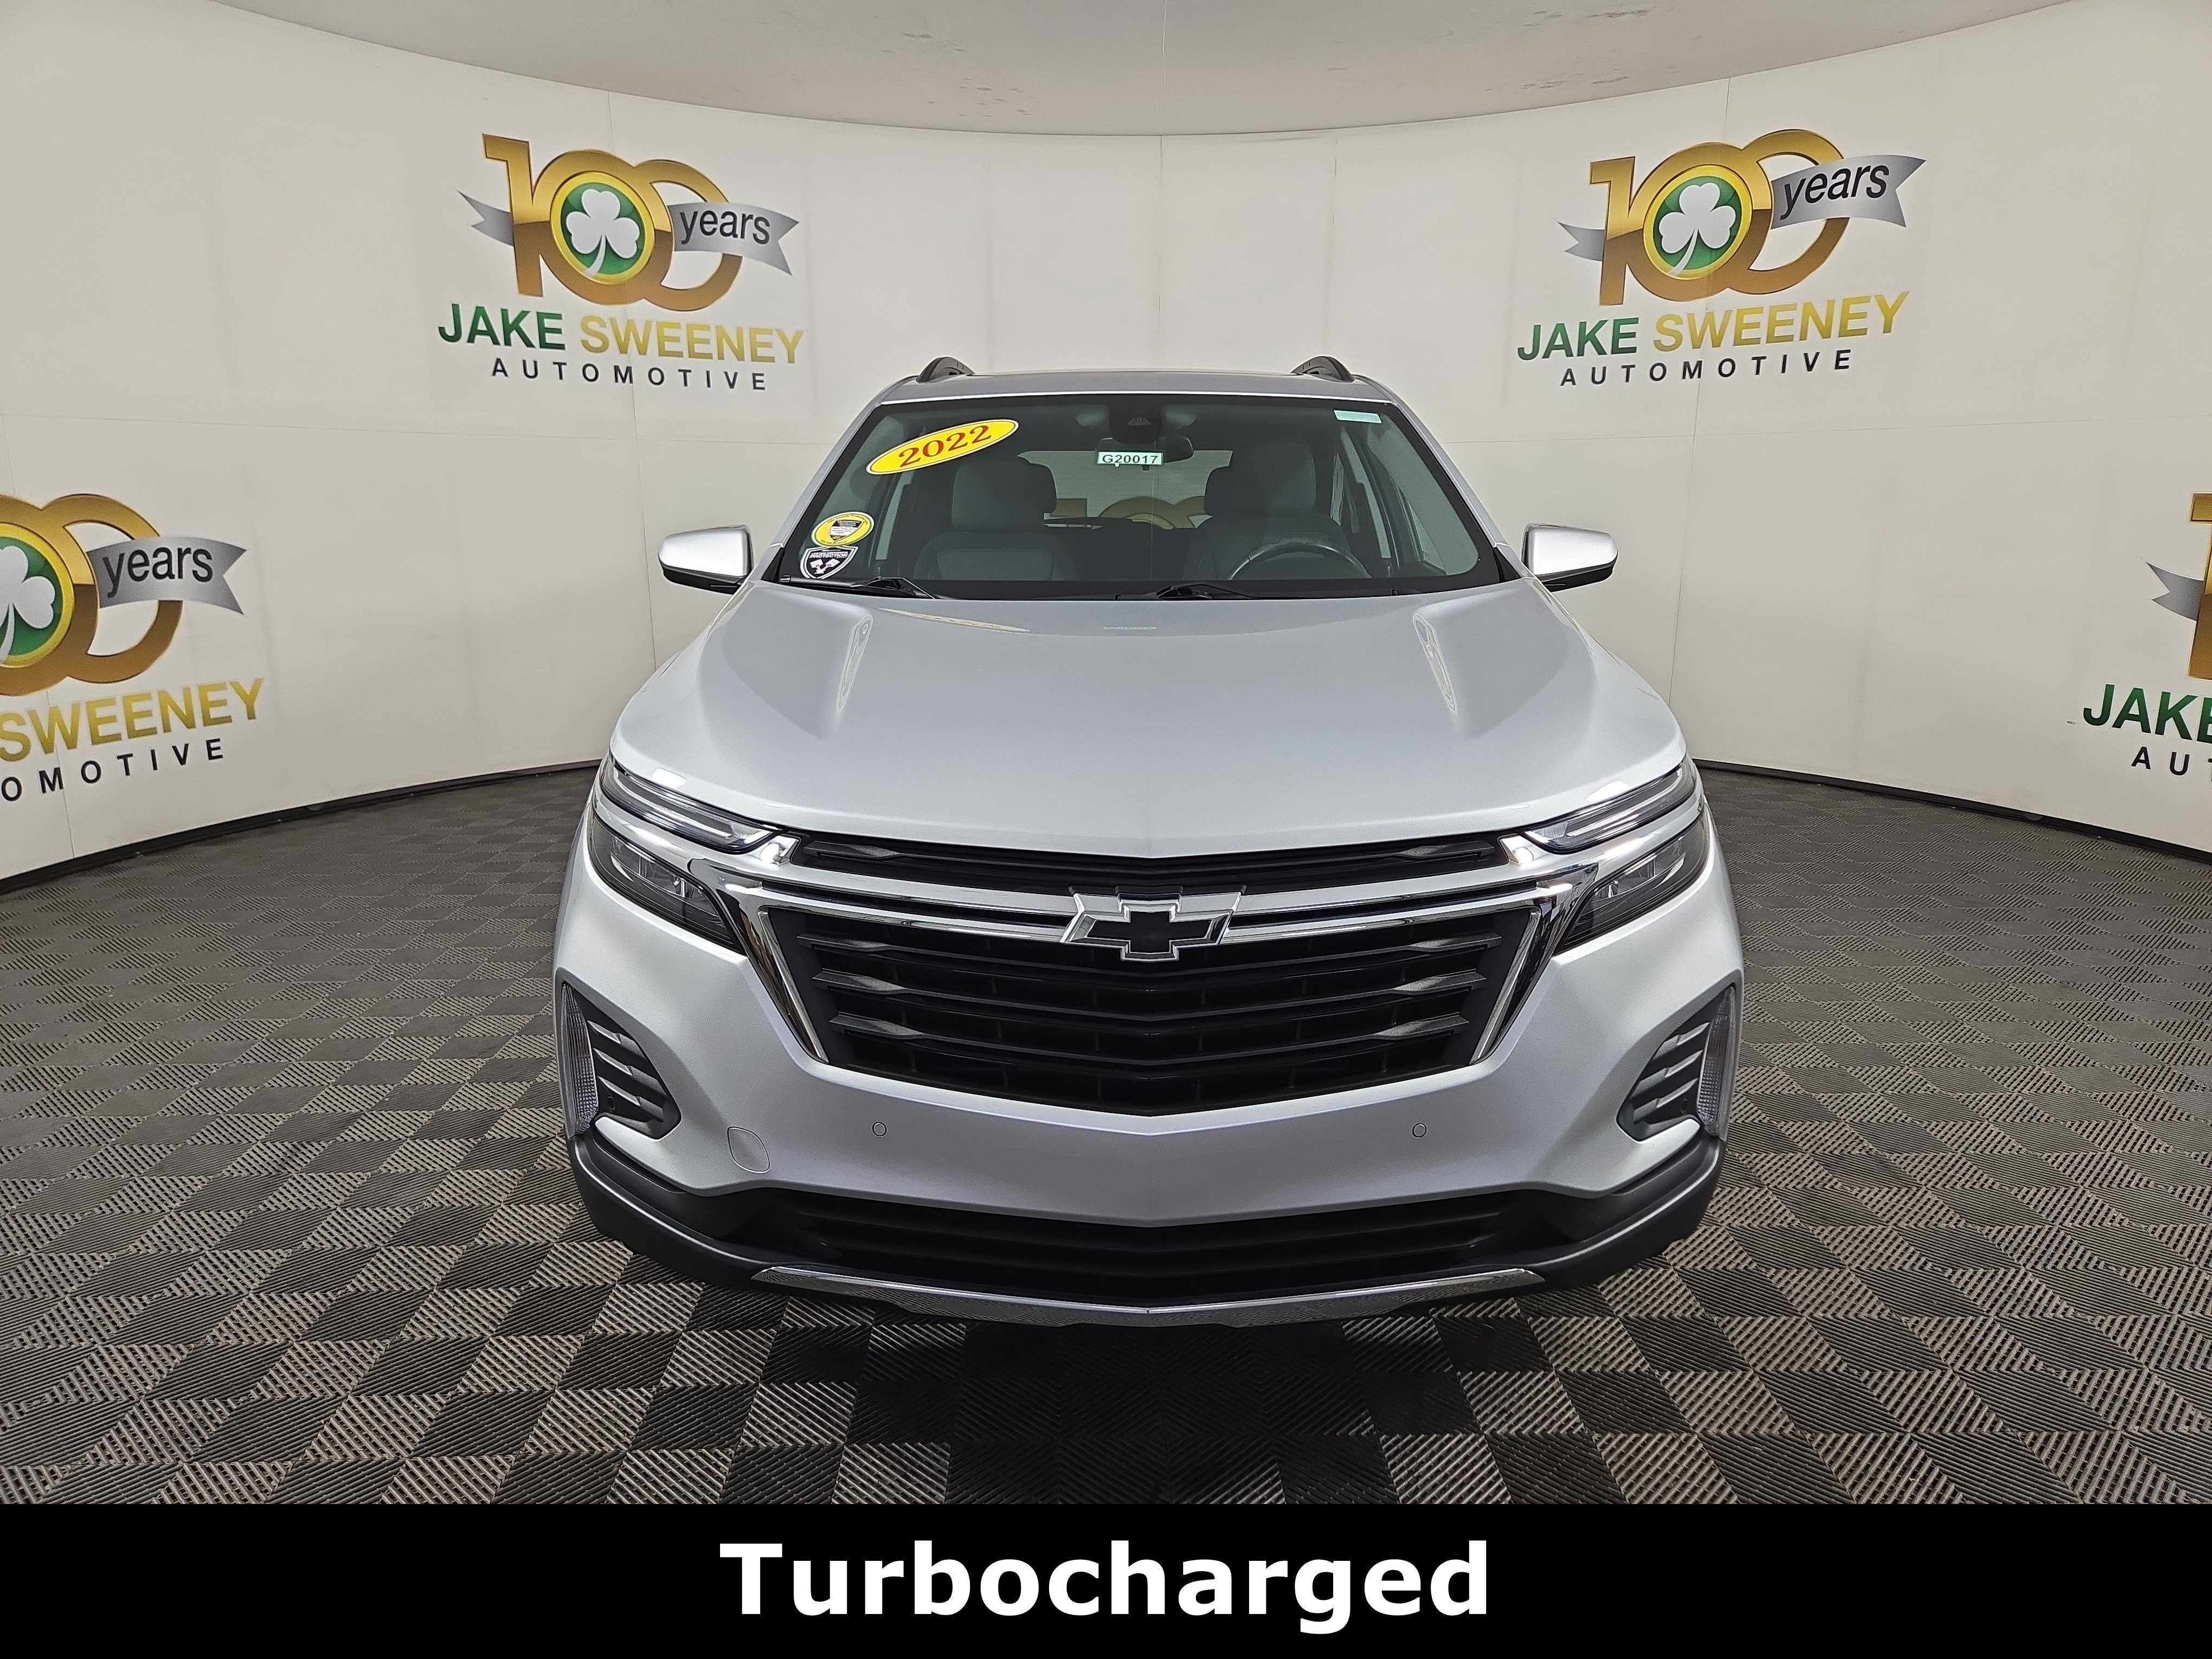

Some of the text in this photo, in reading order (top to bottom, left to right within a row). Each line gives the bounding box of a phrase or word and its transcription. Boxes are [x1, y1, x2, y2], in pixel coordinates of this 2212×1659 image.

[1780, 163, 1889, 219] years
[679, 207, 771, 246] years
[438, 303, 805, 364] JAKE SWEENEY
[1517, 290, 1909, 361] JAKE SWEENEY
[491, 357, 766, 390] AUTOMOTIVE
[1560, 349, 1851, 387] AUTOMOTIVE
[898, 425, 992, 468] 2022
[1102, 454, 1159, 464] G20017
[102, 545, 214, 599] years
[0, 678, 264, 762] SWEENEY
[2131, 746, 2212, 782] AU
